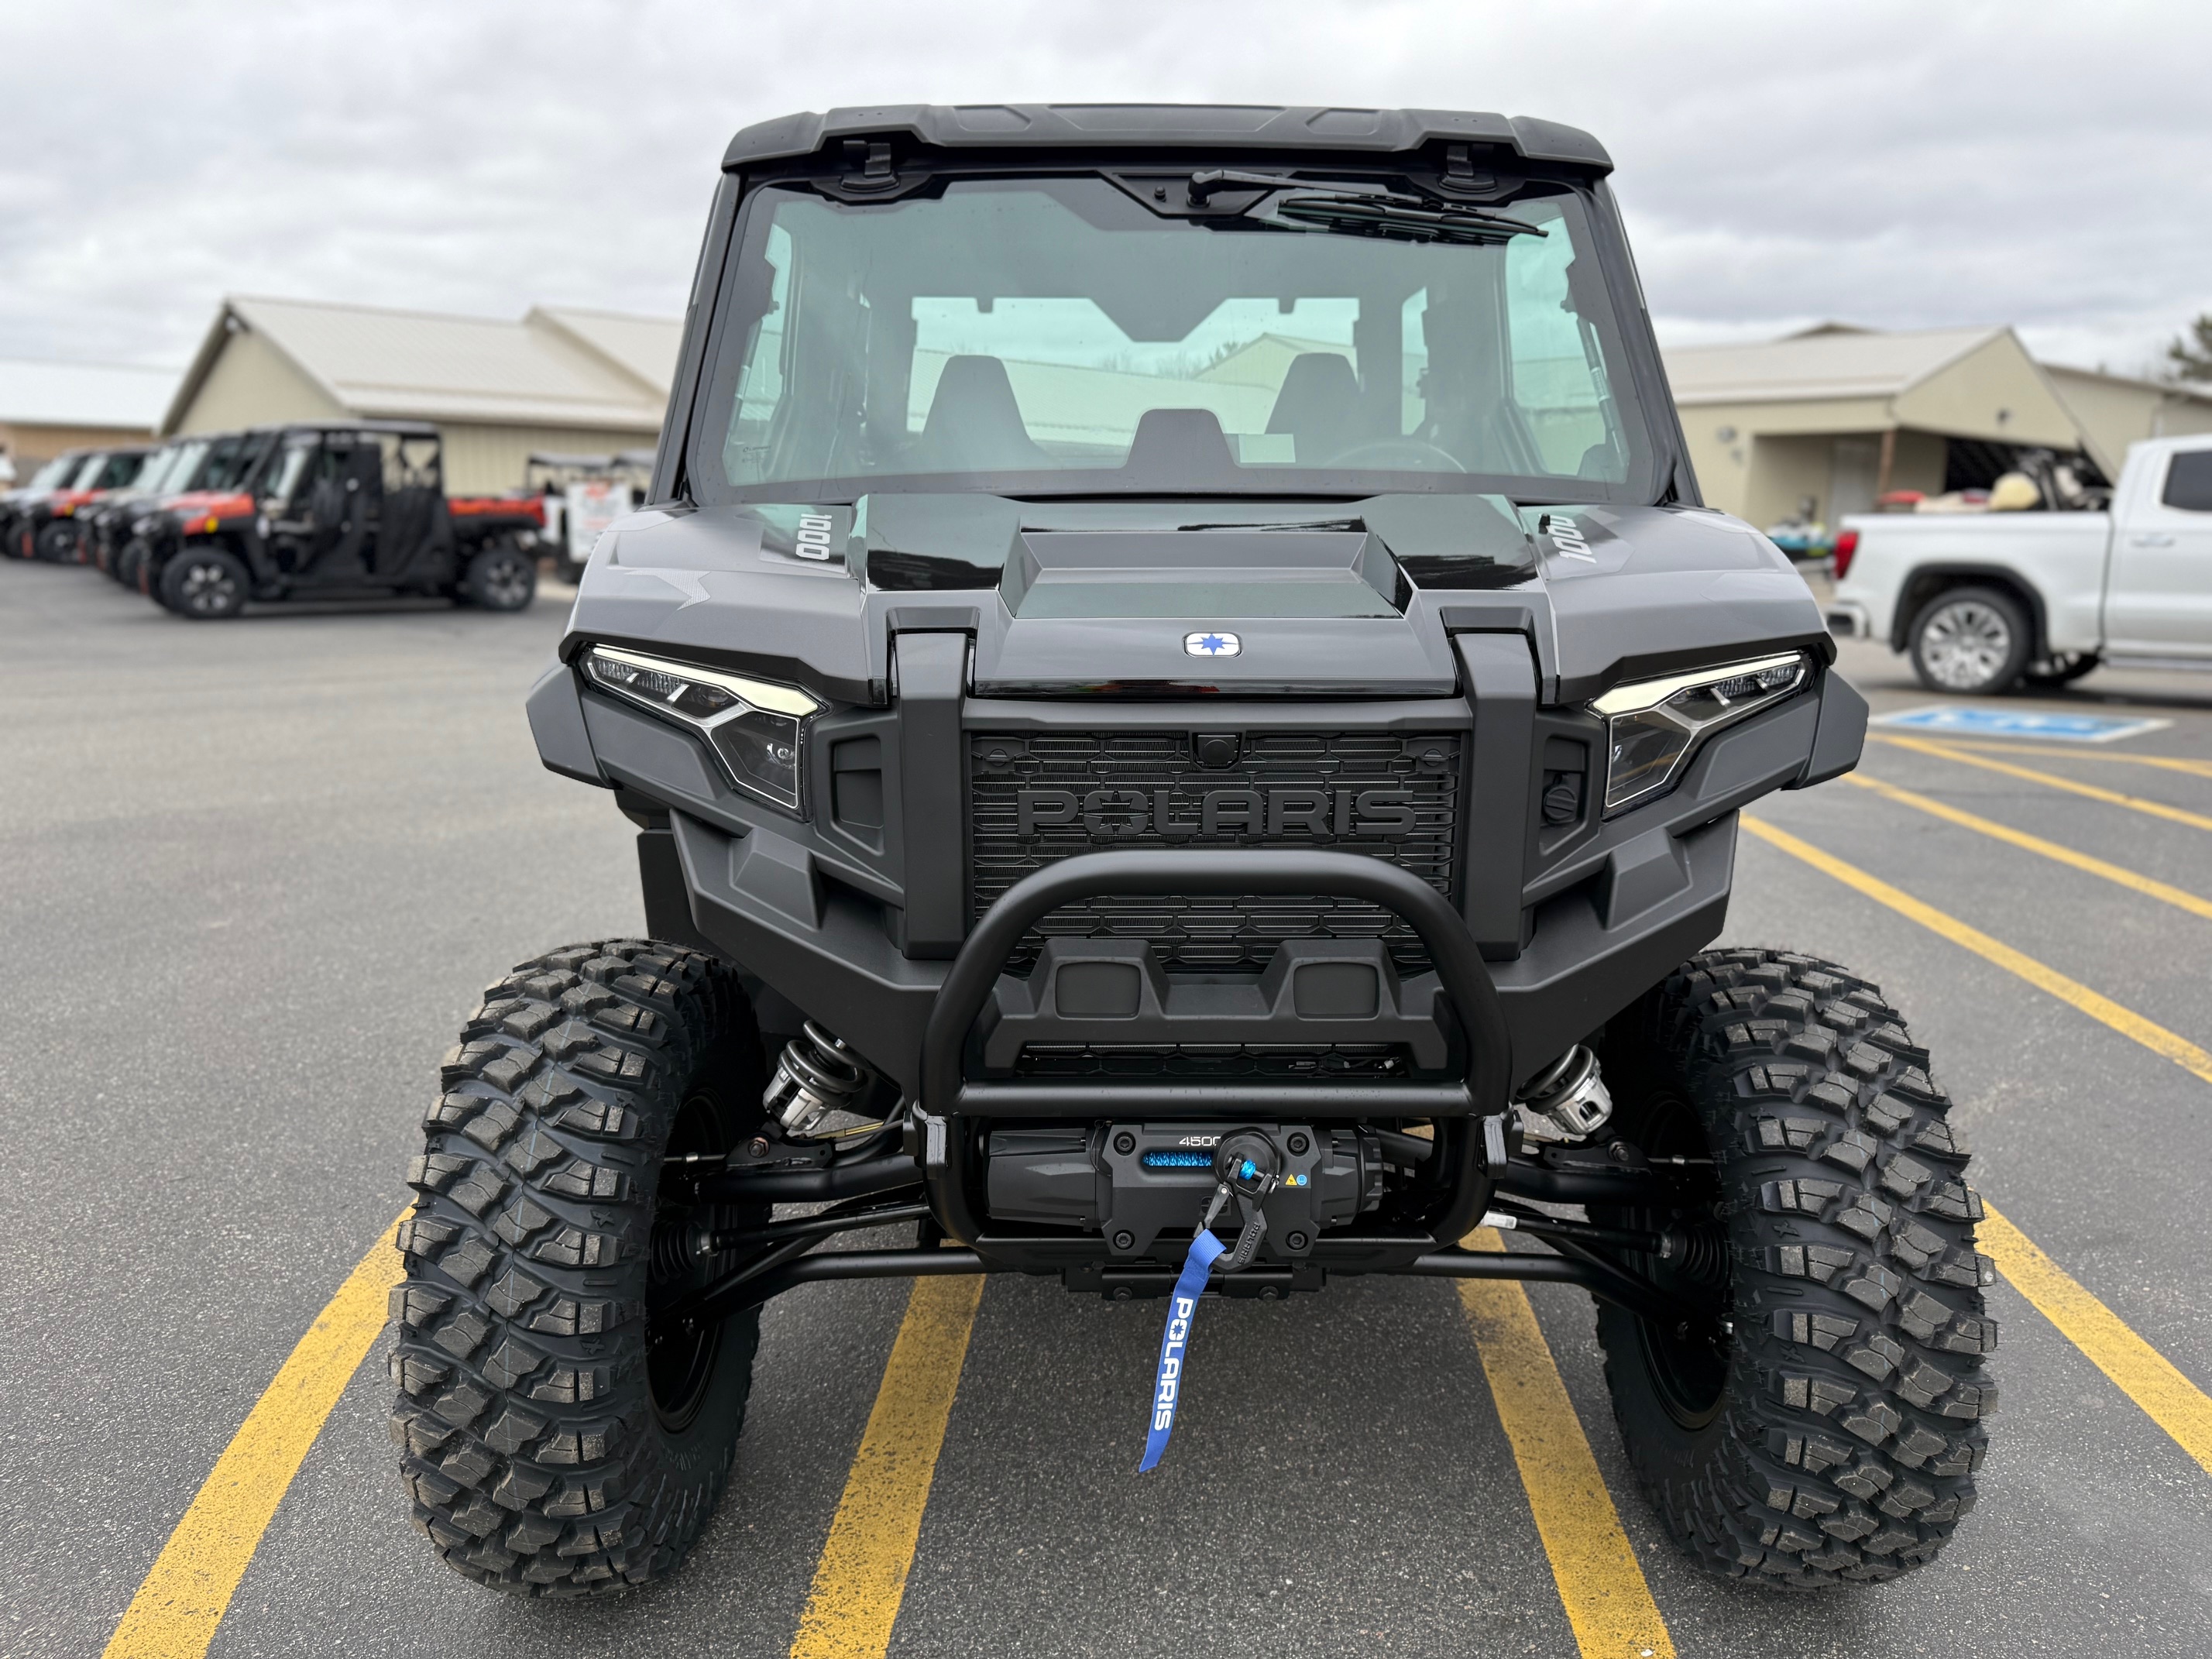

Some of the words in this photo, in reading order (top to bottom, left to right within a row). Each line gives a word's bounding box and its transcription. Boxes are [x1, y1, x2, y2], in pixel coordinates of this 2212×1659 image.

[795, 514, 833, 561] 1000
[1017, 790, 1416, 836] POLARIS
[1238, 1221, 1260, 1265] POLARIS
[1154, 1297, 1194, 1431] POLARIS
